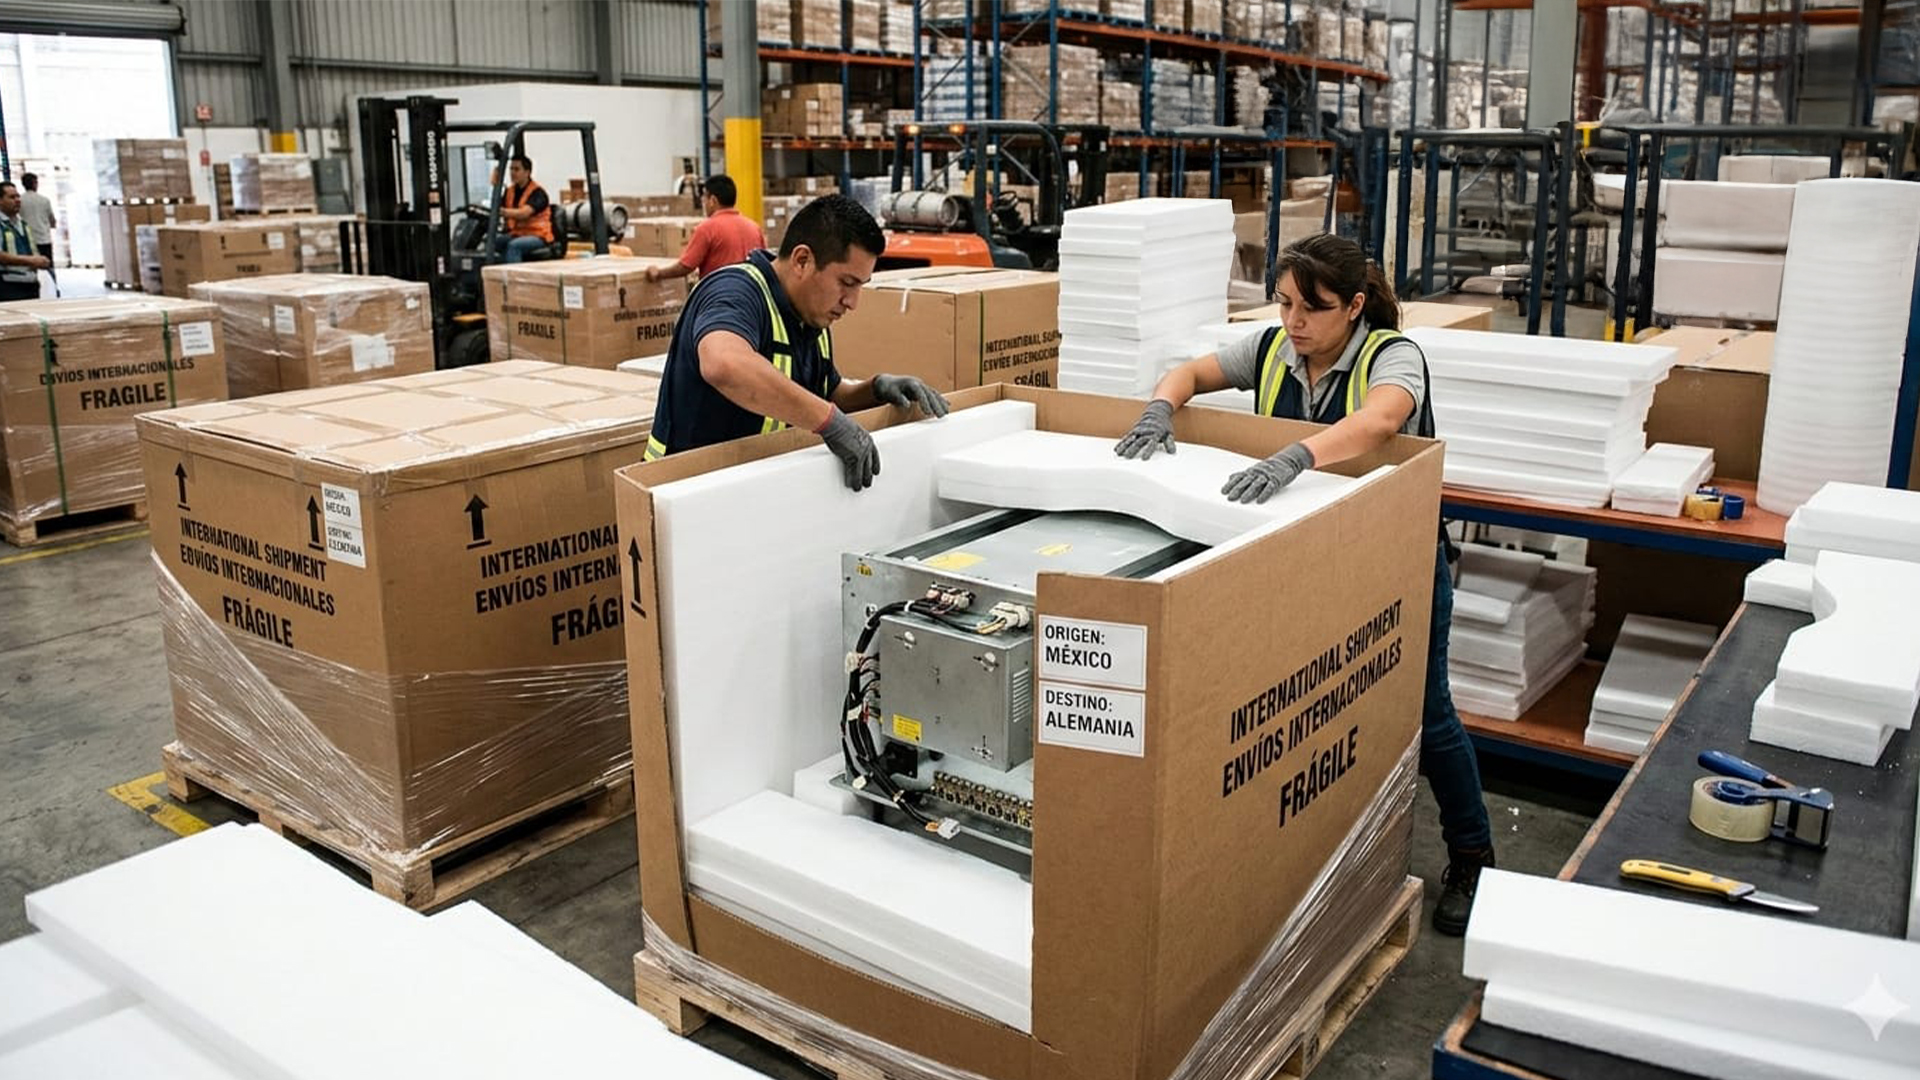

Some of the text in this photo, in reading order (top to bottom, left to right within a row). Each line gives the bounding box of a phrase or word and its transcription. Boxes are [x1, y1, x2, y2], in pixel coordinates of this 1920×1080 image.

[80, 382, 167, 411] FRAGILE
[264, 543, 327, 582] SHIPMENT
[475, 554, 621, 614] ENVÍOS INTERN
[223, 595, 294, 649] FRÁGILE
[1045, 624, 1105, 646] ORIGEN:
[1045, 644, 1112, 670] MÉXICO
[1230, 598, 1402, 744] INTERNATIONAL SHIPMENT
[1045, 689, 1112, 712] DESTINO:
[1222, 636, 1402, 798] ENVÍOS INTERNACIONALES
[1045, 711, 1135, 739] ALEMANIA
[1278, 725, 1359, 829] FRÁGILE
